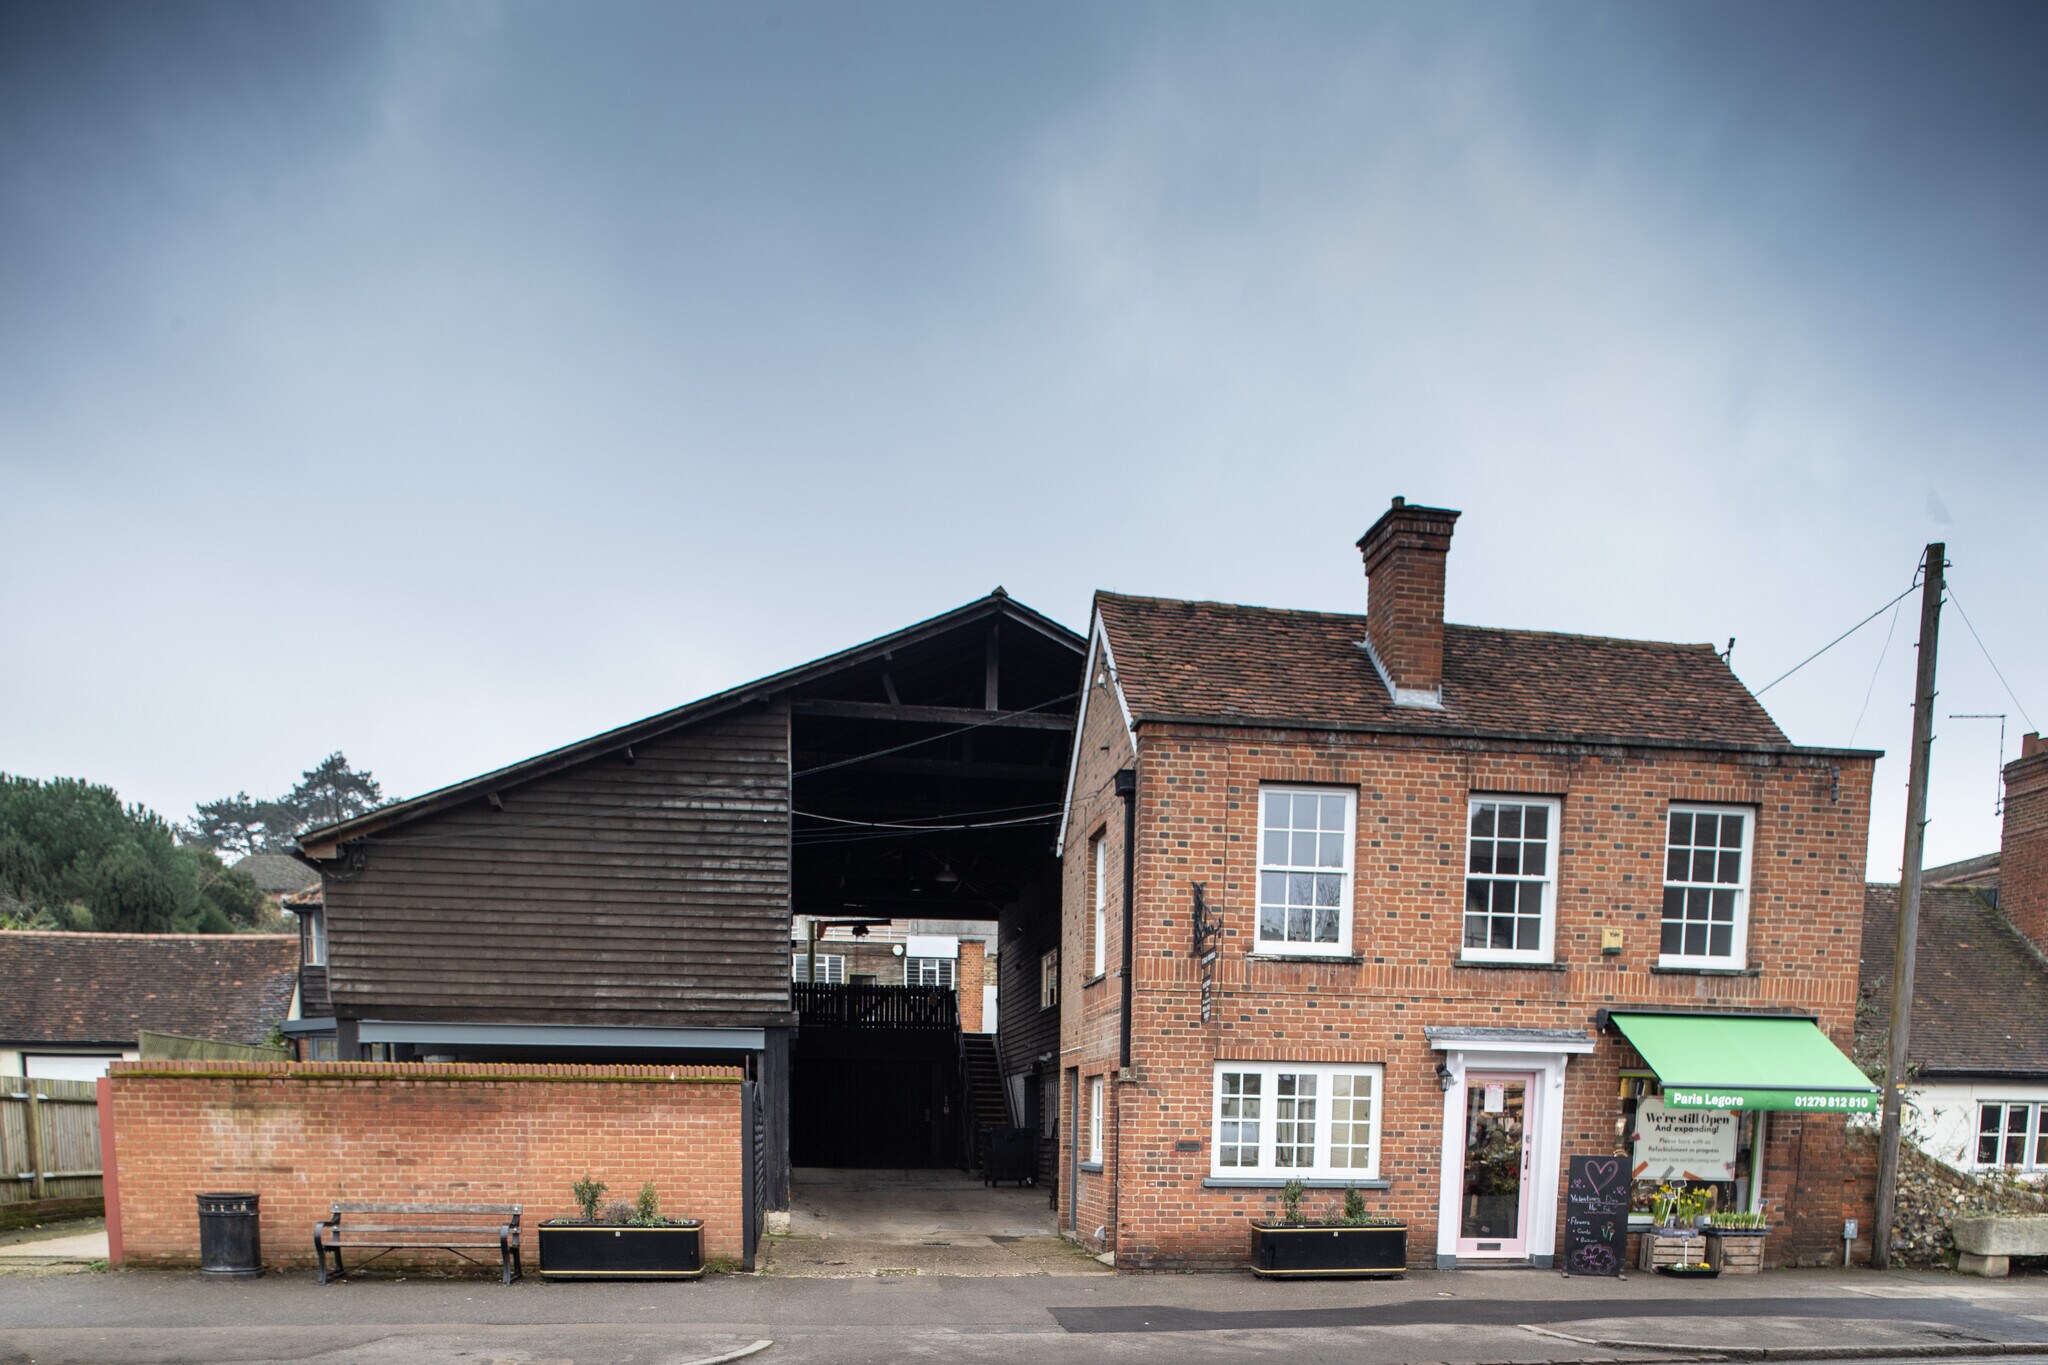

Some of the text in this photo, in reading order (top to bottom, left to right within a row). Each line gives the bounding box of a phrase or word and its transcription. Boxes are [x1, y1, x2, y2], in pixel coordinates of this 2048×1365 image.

[1673, 1092, 1744, 1107] Paris Legore
[1794, 1096, 1869, 1108] 01279 812 810
[1646, 1112, 1730, 1126] We're still Open
[1655, 1124, 1719, 1135] And expanding!
